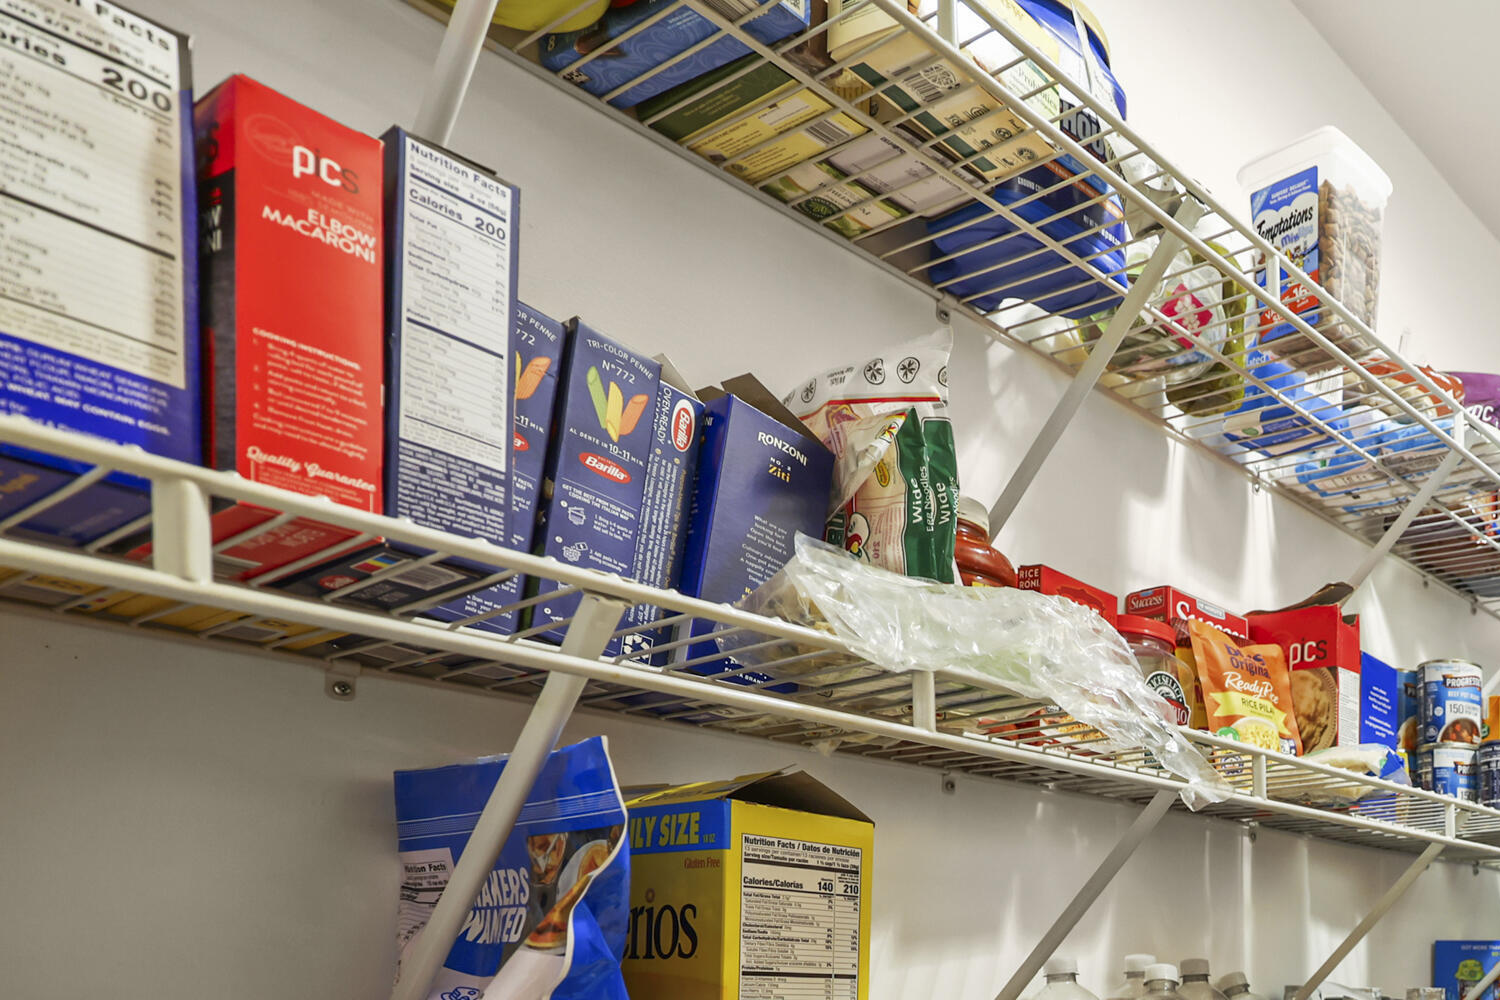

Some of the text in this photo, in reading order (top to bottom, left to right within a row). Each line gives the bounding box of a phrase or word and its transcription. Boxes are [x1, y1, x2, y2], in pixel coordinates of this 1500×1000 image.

[102, 67, 173, 113] 200
[291, 145, 360, 194] pics
[409, 142, 507, 199] Nutrition Facts
[409, 163, 441, 185] Serving
[307, 209, 376, 249] ELBOW
[409, 188, 506, 241] Calories 200
[1255, 205, 1315, 243] Temptations
[262, 205, 376, 264] MACARONI
[529, 318, 558, 342] PENNE
[586, 338, 655, 380] TRI-COLOR PENNE
[655, 387, 672, 445] OVEN-READY
[674, 409, 691, 448] Barilla
[579, 431, 631, 460] DENTE 10-11
[757, 430, 809, 467] RONZONI
[769, 456, 784, 468] NO.
[247, 446, 377, 492] Quality Guarantee
[584, 454, 628, 481] Barilla
[768, 463, 791, 484] Ziti
[912, 477, 924, 525] Wide
[917, 465, 936, 516] Noodles
[938, 481, 951, 526] Wide
[1018, 568, 1040, 579] RICE
[1129, 594, 1164, 611] Success
[1289, 637, 1328, 672] pics
[1223, 671, 1261, 700] Ready
[1241, 697, 1257, 710] RICE
[1448, 703, 1464, 714] 150
[658, 811, 700, 847] SIZE
[744, 835, 776, 847] Nutrition
[777, 839, 796, 850] Facts
[802, 843, 821, 853] Datos
[831, 847, 860, 858] Nutrición
[683, 856, 721, 869] Gluten Free
[743, 875, 804, 890] Calories/Calorías
[817, 880, 834, 893] 140
[843, 883, 859, 895] 210
[457, 906, 528, 945] WANTED
